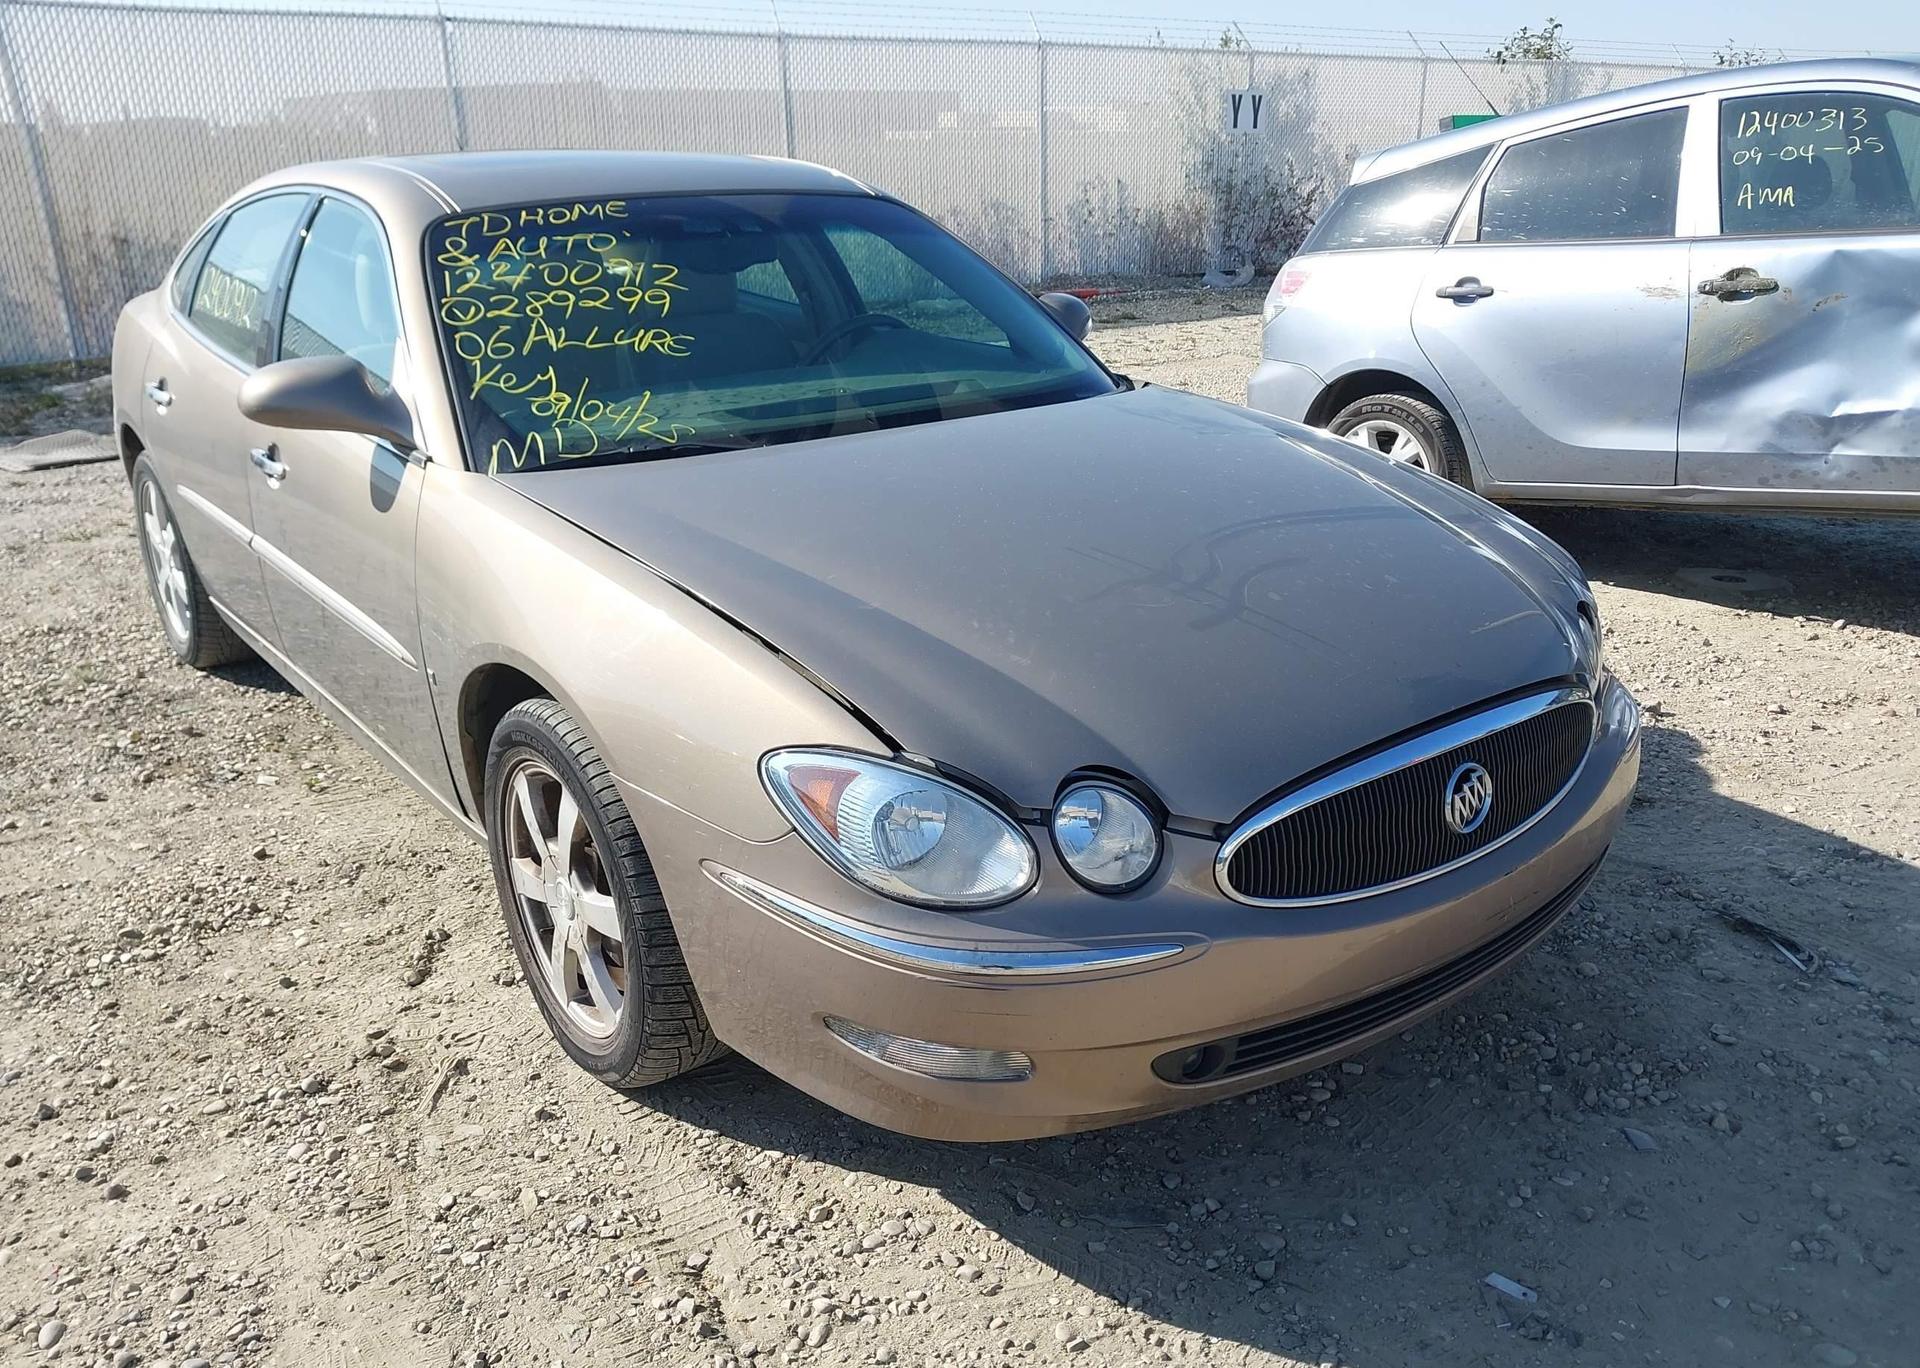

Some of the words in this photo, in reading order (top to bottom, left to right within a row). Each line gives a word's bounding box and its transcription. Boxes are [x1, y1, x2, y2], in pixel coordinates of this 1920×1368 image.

[1737, 107, 1868, 139] 12400313
[1736, 182, 1796, 210] AMA
[520, 201, 629, 231] HOME
[437, 237, 480, 266] &
[454, 325, 515, 360] 06
